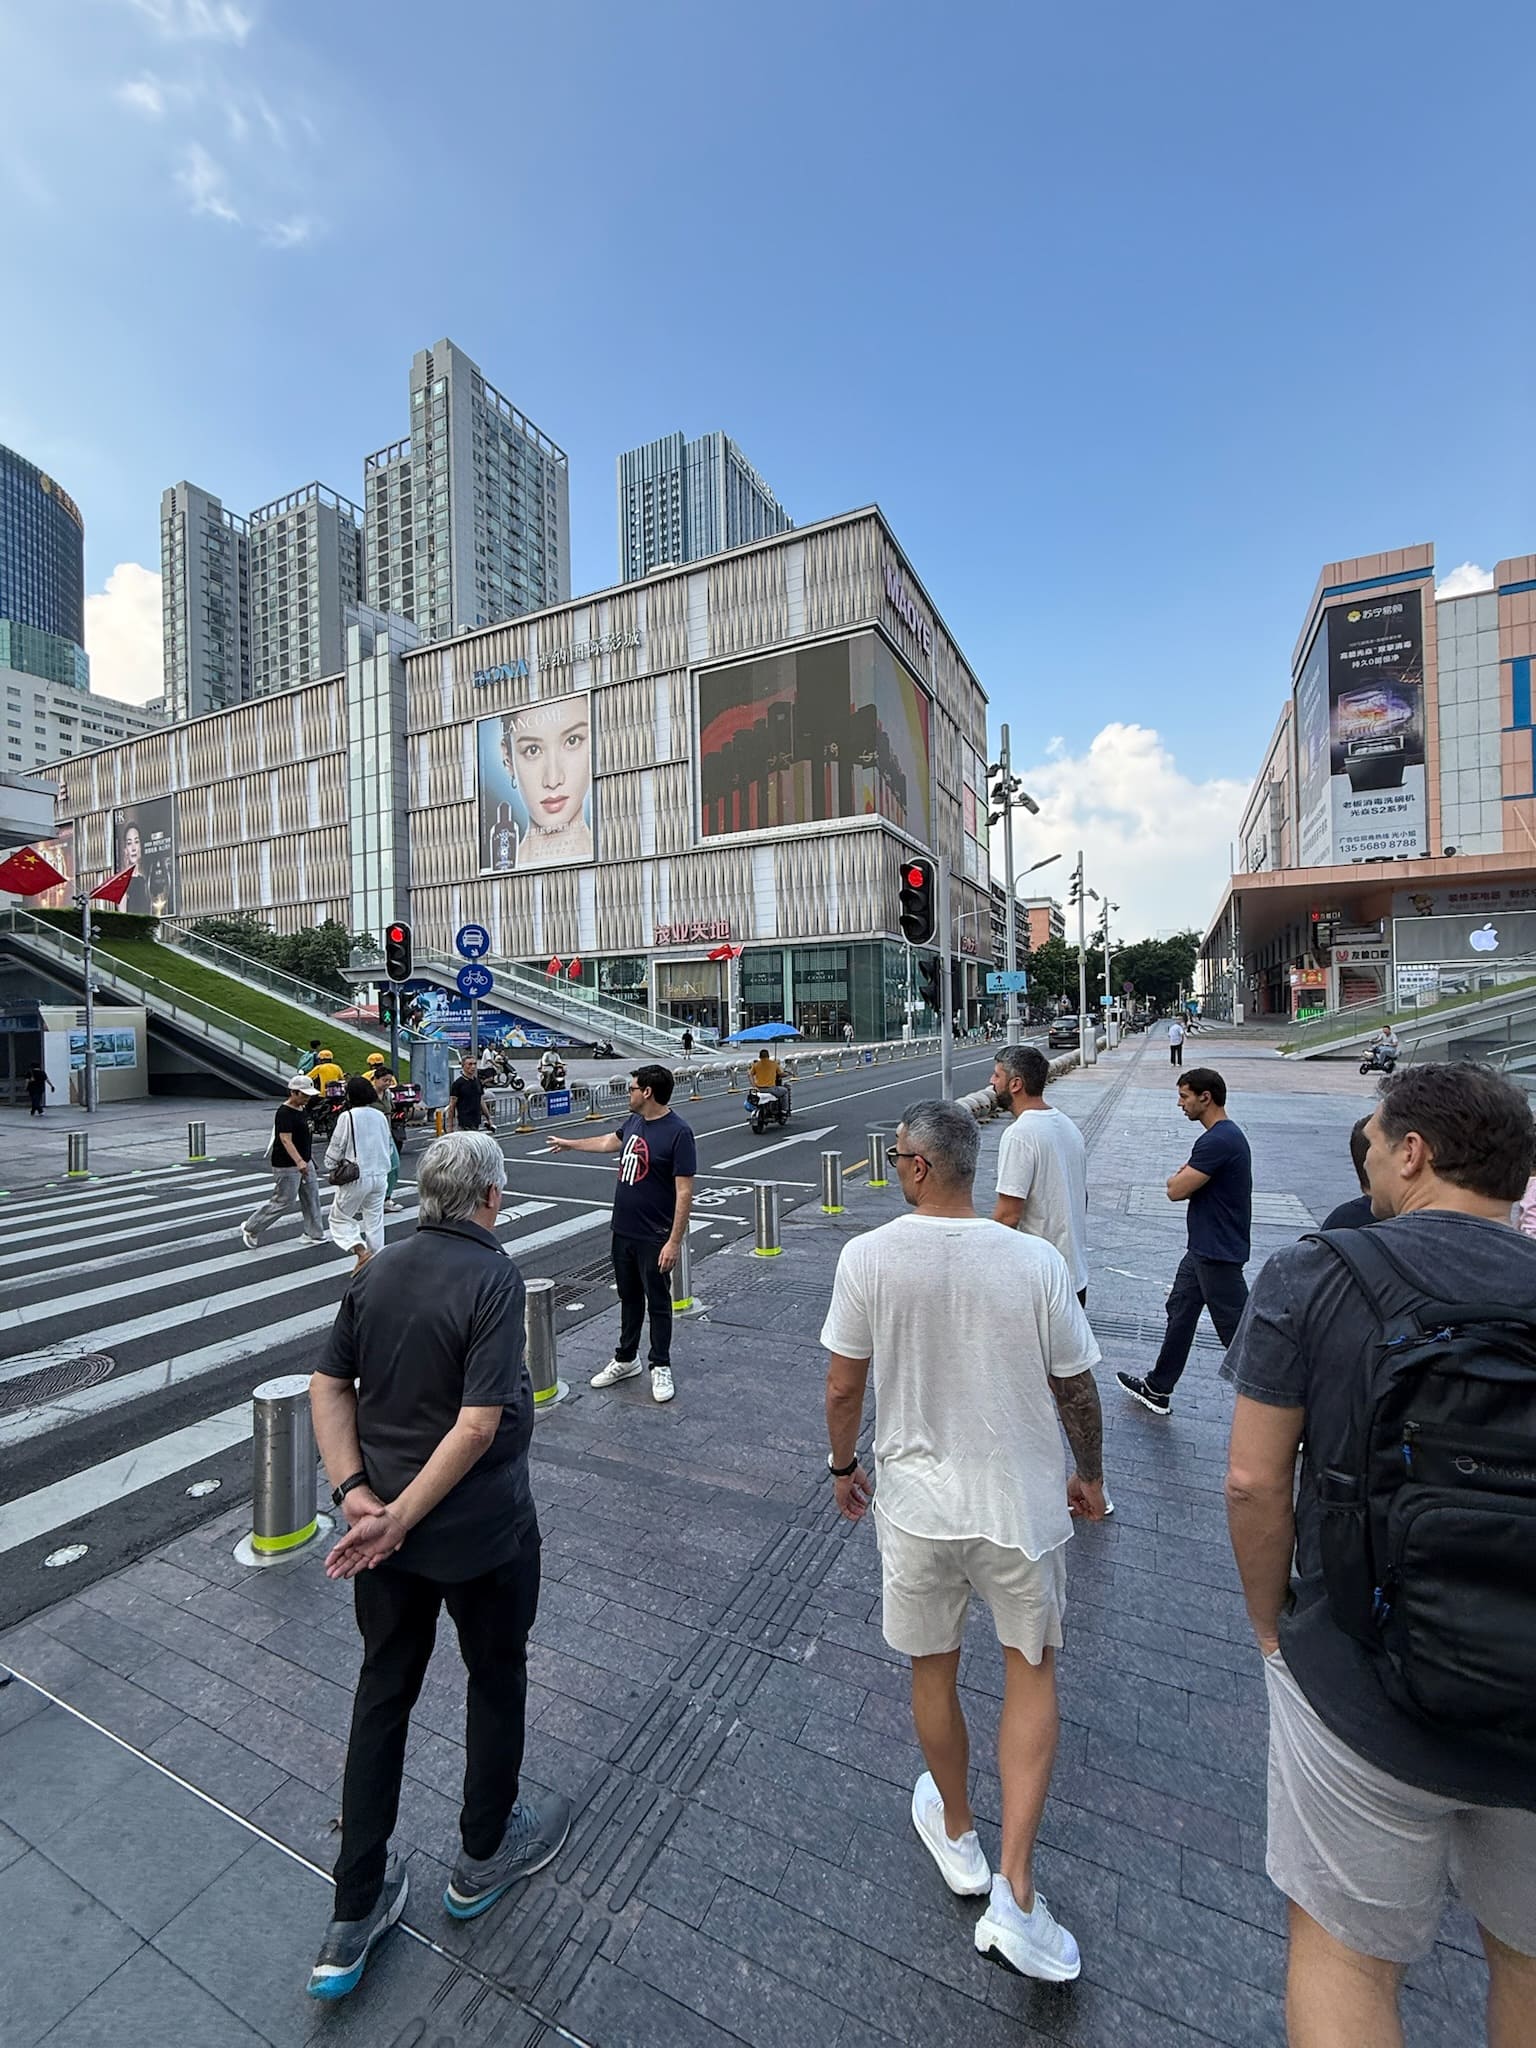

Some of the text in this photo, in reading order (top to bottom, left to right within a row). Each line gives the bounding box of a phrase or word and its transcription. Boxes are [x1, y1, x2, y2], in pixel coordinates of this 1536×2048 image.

[884, 563, 931, 658] MAOYE
[1362, 604, 1404, 619] 苏宁易购
[473, 658, 529, 689] BONA
[1342, 794, 1416, 809] 老板消毒洗碗机
[1340, 838, 1417, 853] 135 5689 8788
[654, 920, 730, 946] 茂业天地
